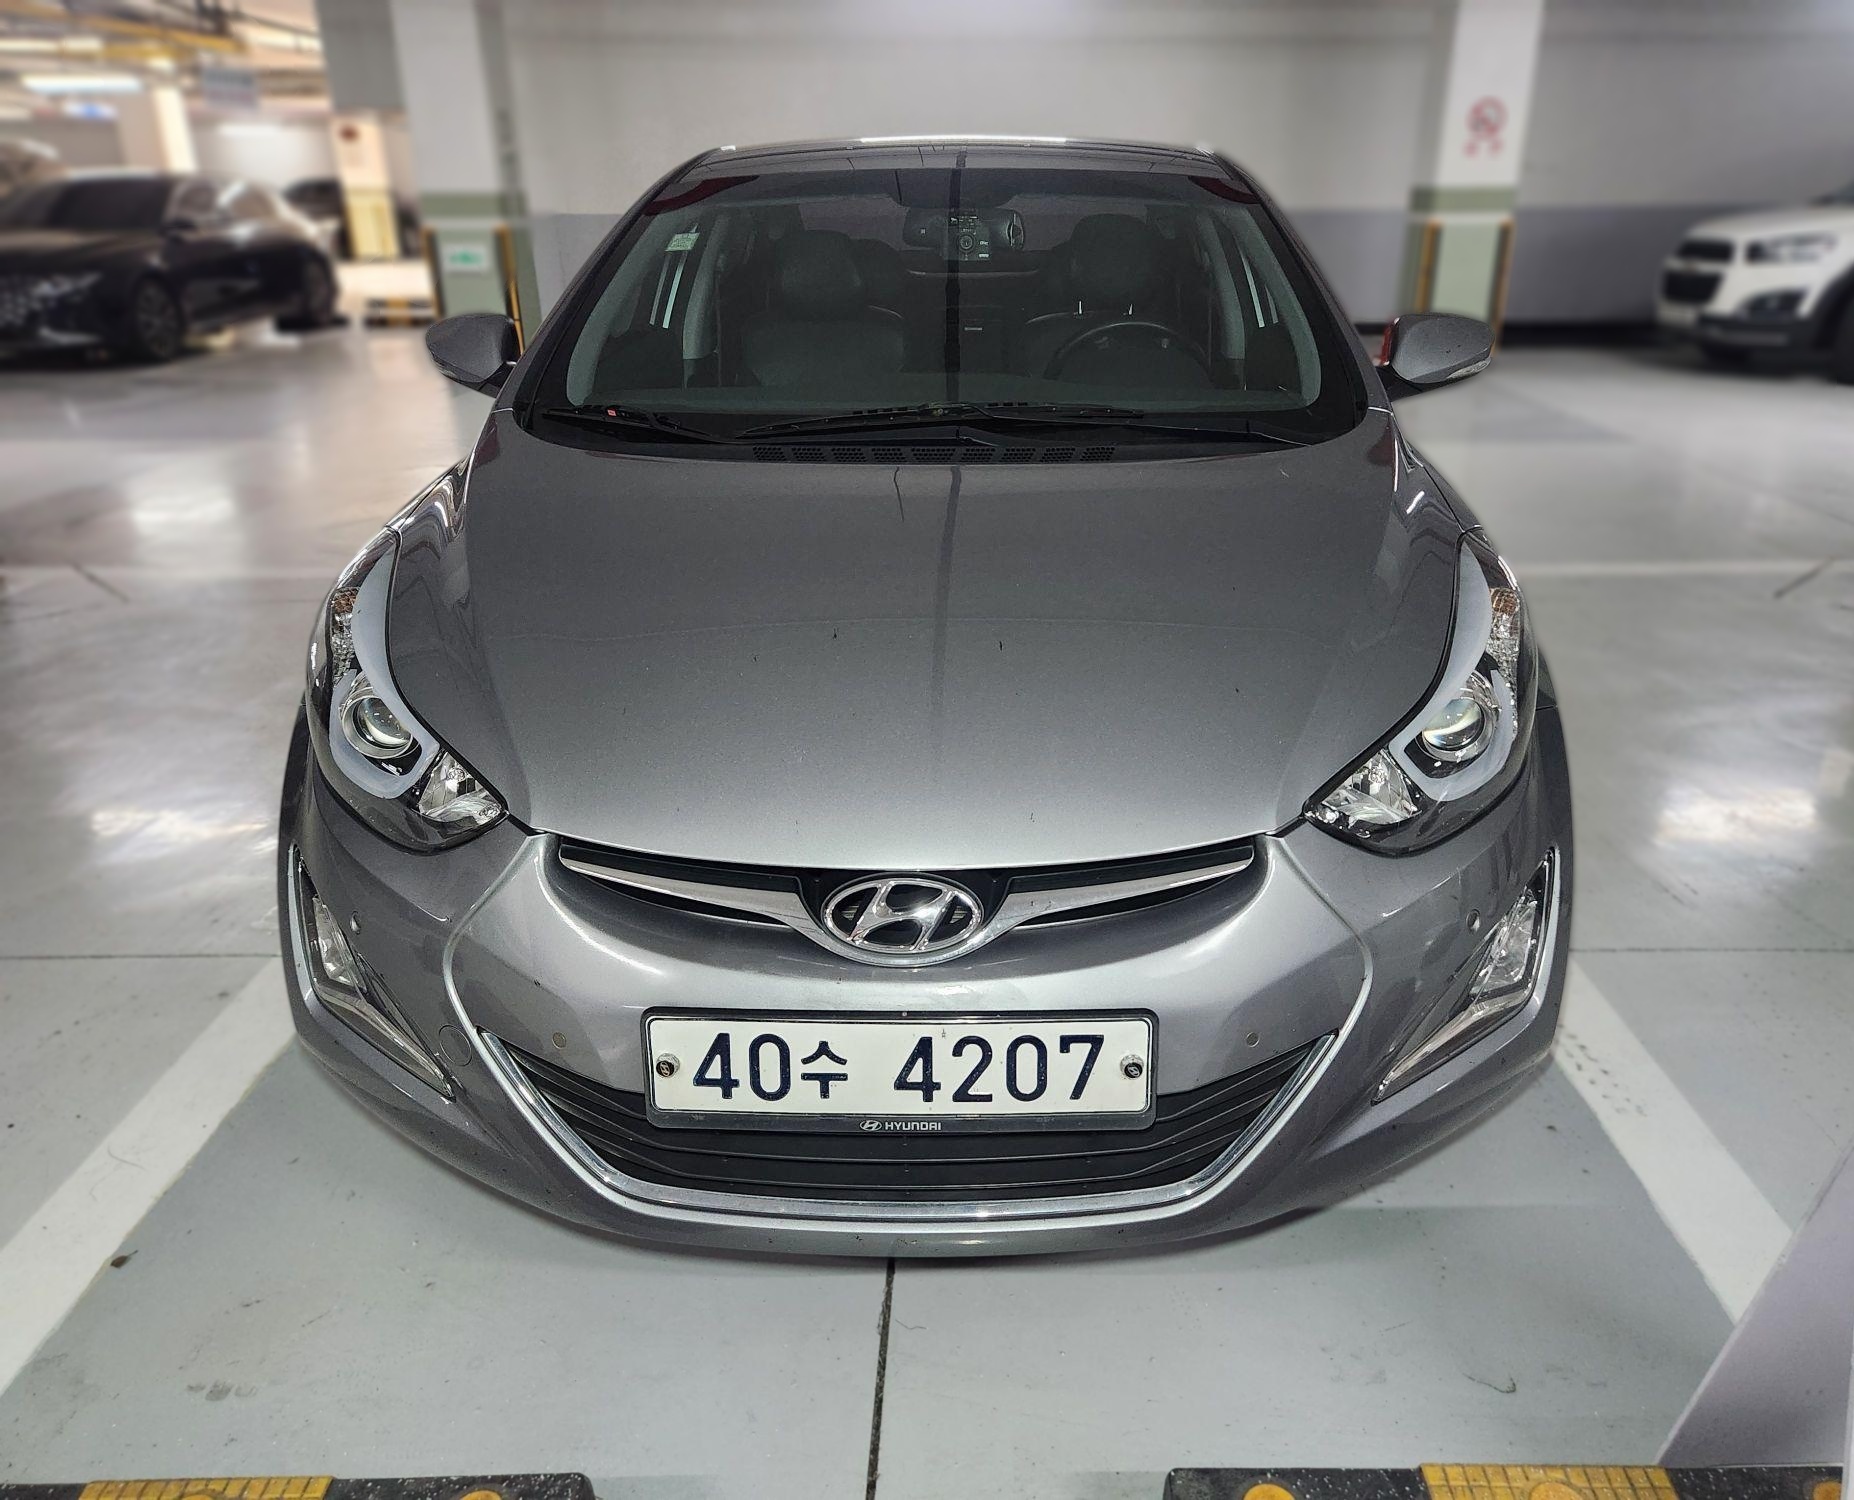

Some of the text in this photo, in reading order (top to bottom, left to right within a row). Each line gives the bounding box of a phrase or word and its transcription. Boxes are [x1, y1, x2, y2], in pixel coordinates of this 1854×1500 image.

[692, 1032, 1105, 1103] 40수 4207
[884, 1121, 942, 1131] HYUNDAI
